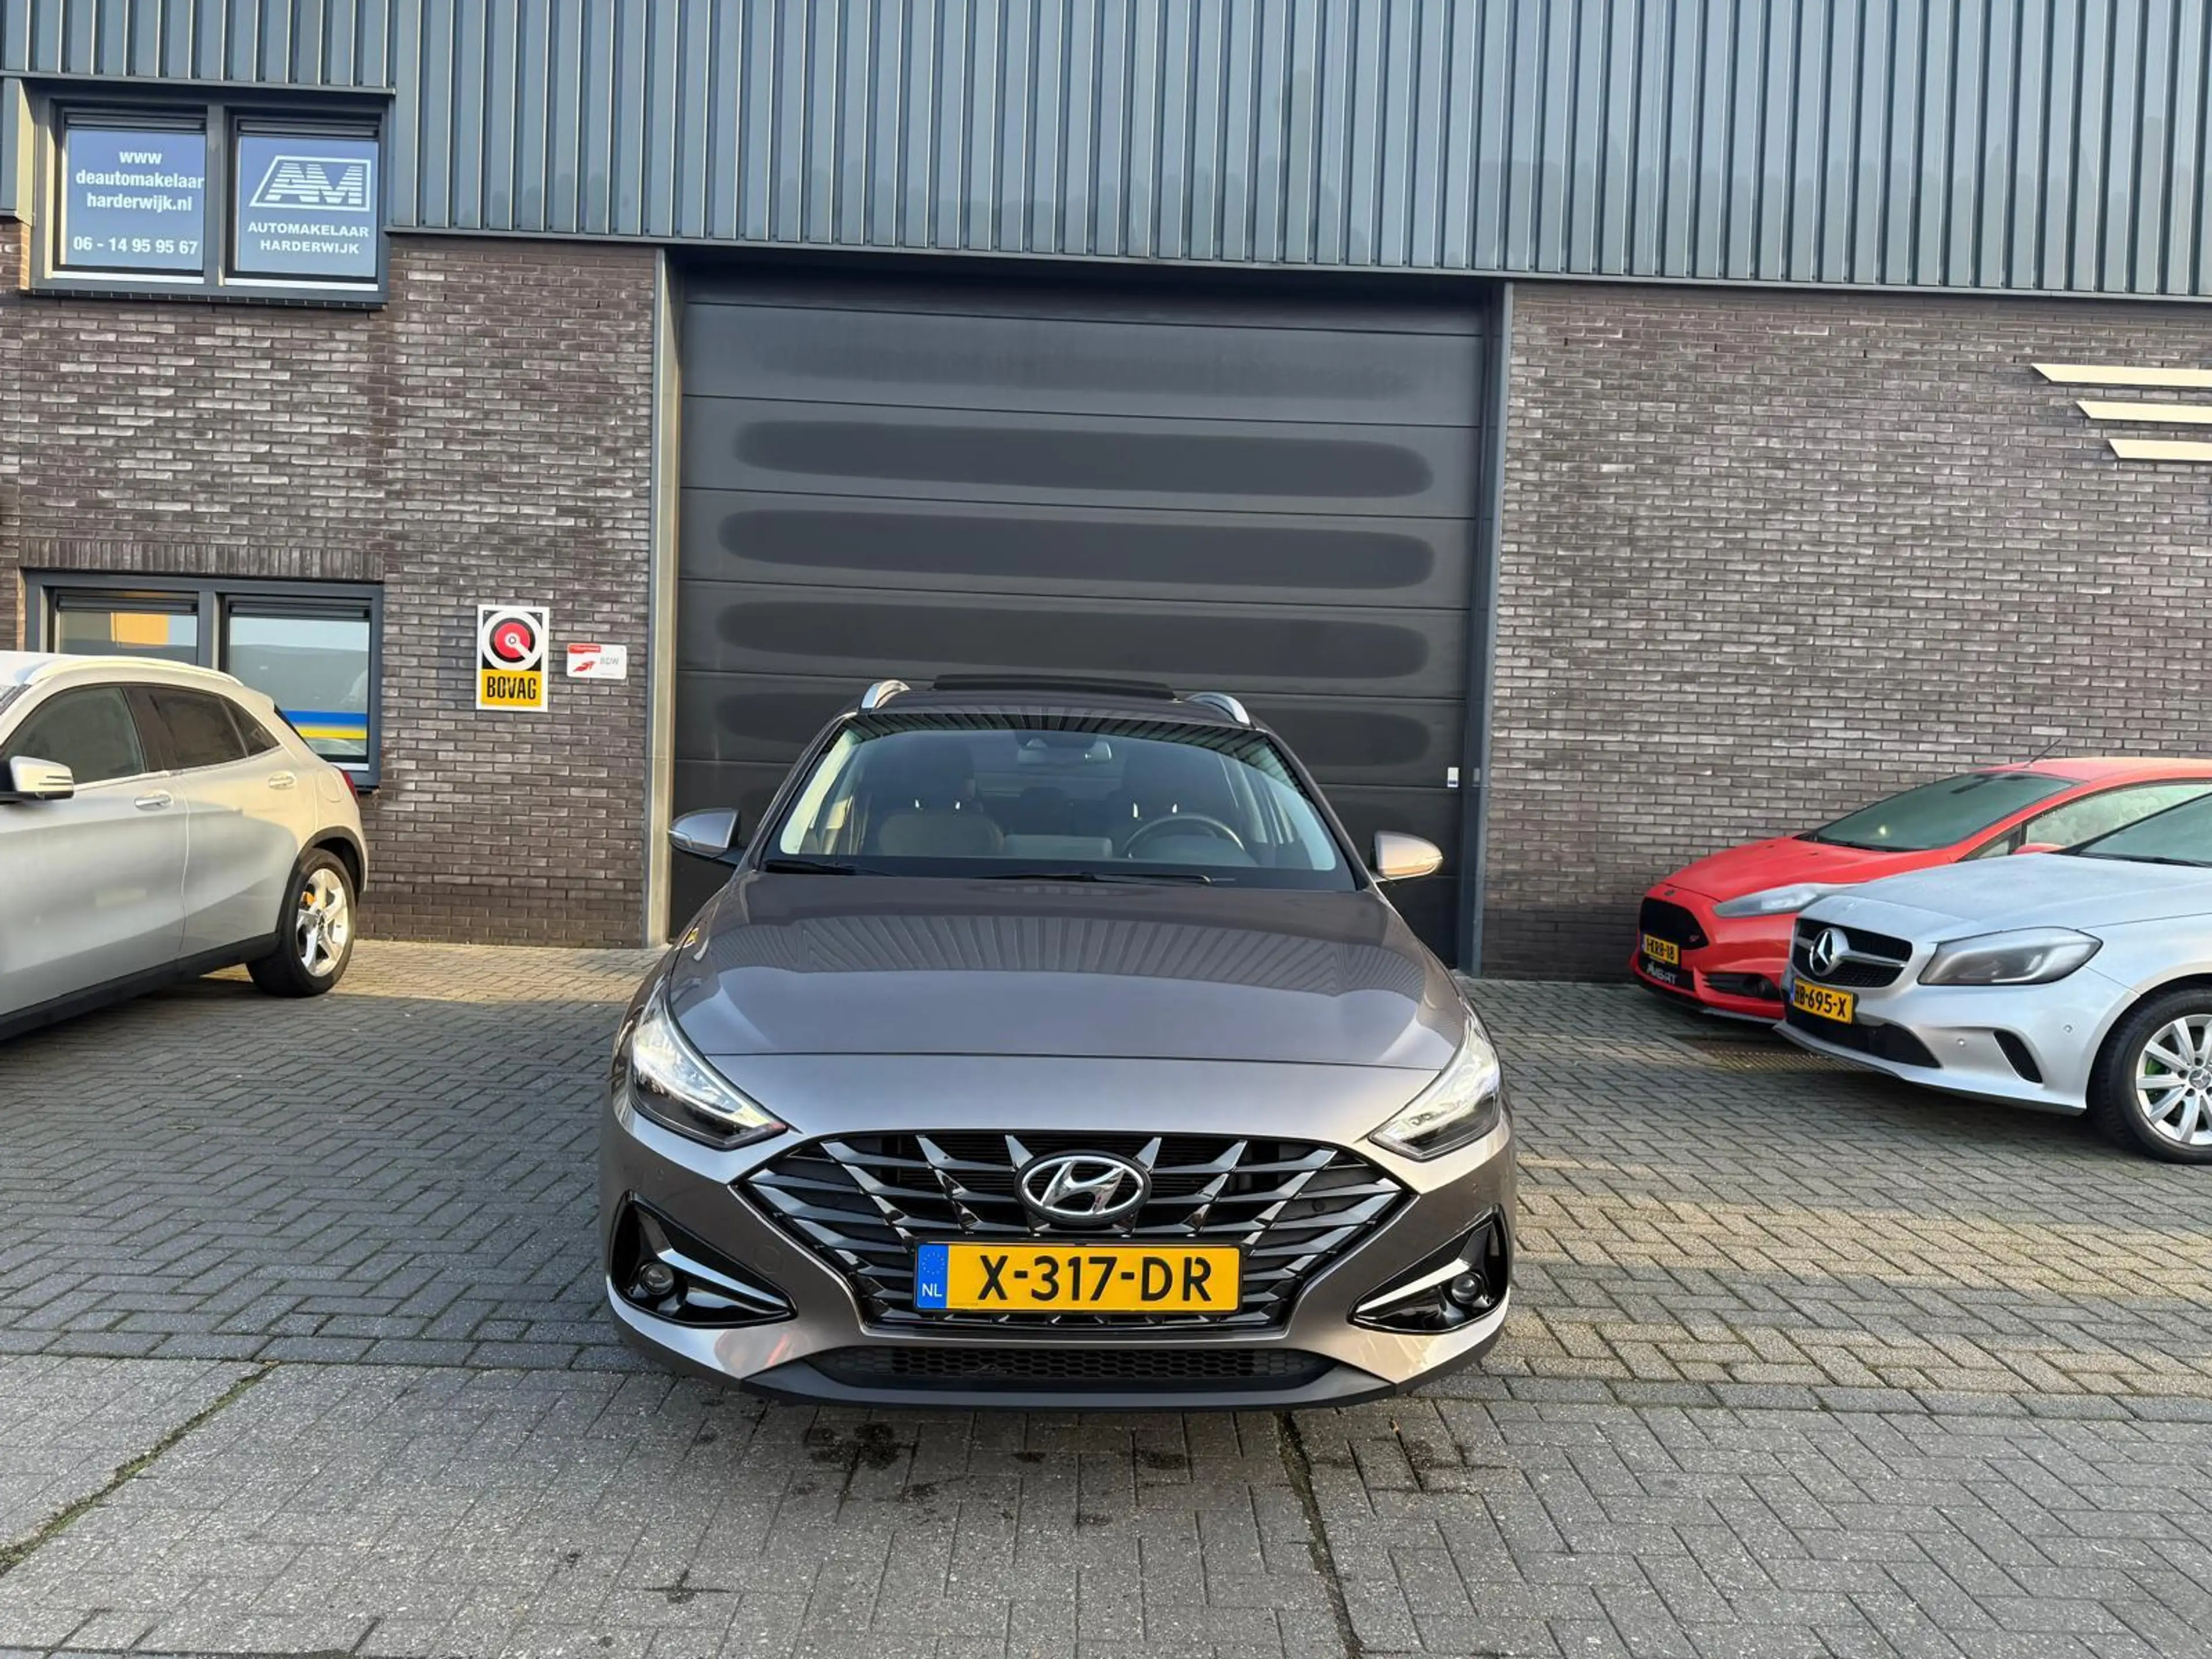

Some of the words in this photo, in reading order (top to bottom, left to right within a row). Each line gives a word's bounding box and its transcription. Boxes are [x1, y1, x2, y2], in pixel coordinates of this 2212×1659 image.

[119, 151, 162, 164] www
[75, 169, 204, 189] deautomakelaar
[87, 192, 192, 213] harderwijk.nl
[248, 221, 369, 237] AUTOMAKELAAR
[73, 236, 93, 251] 06
[108, 237, 127, 252] 14
[132, 238, 151, 252] 95
[156, 240, 175, 253] 95
[179, 241, 198, 255] 67
[261, 240, 359, 254] HARDERWIJK
[486, 676, 537, 700] BOVAG
[978, 1255, 1212, 1301] X-317-DR
[922, 1283, 942, 1297] NL
